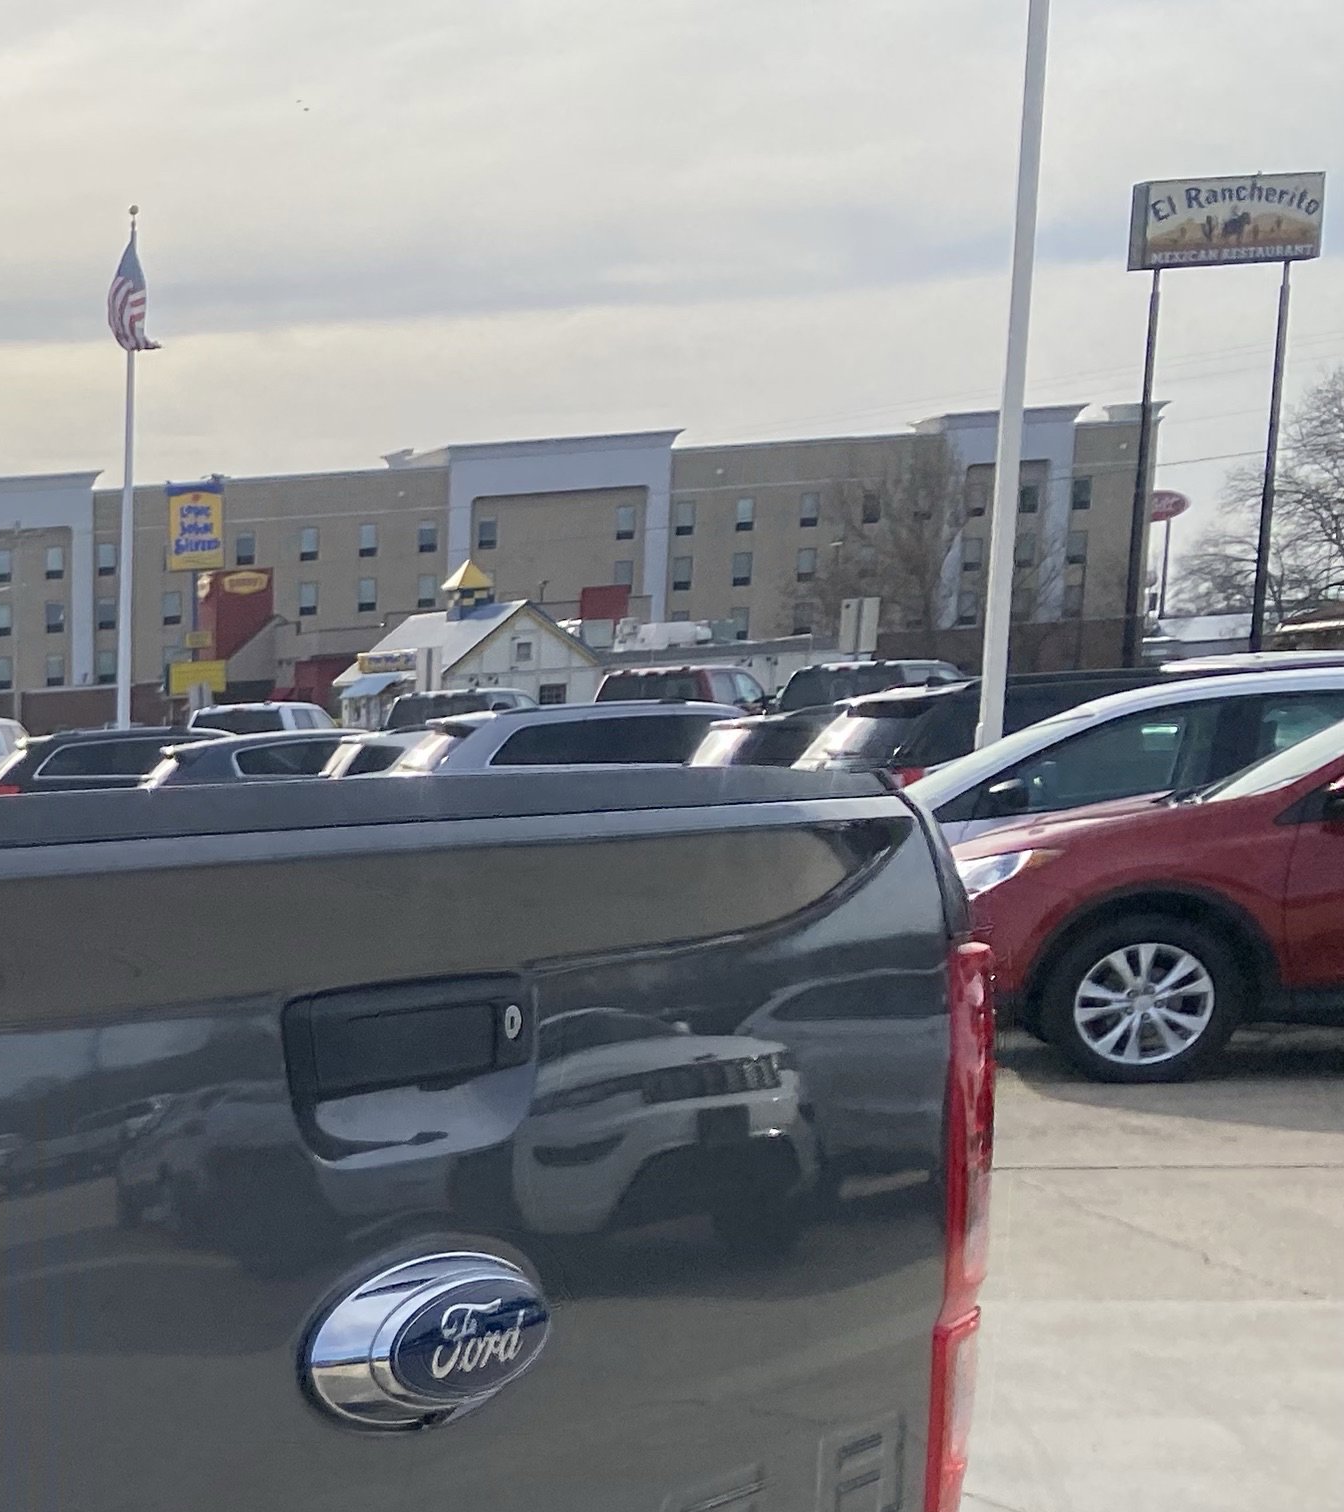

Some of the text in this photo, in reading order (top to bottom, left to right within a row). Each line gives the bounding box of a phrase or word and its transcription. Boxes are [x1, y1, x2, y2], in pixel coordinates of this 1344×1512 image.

[1151, 178, 1320, 224] El Rancherito
[1151, 244, 1314, 264] MEXICAN RESTAURANT
[430, 1298, 526, 1380] Ford
